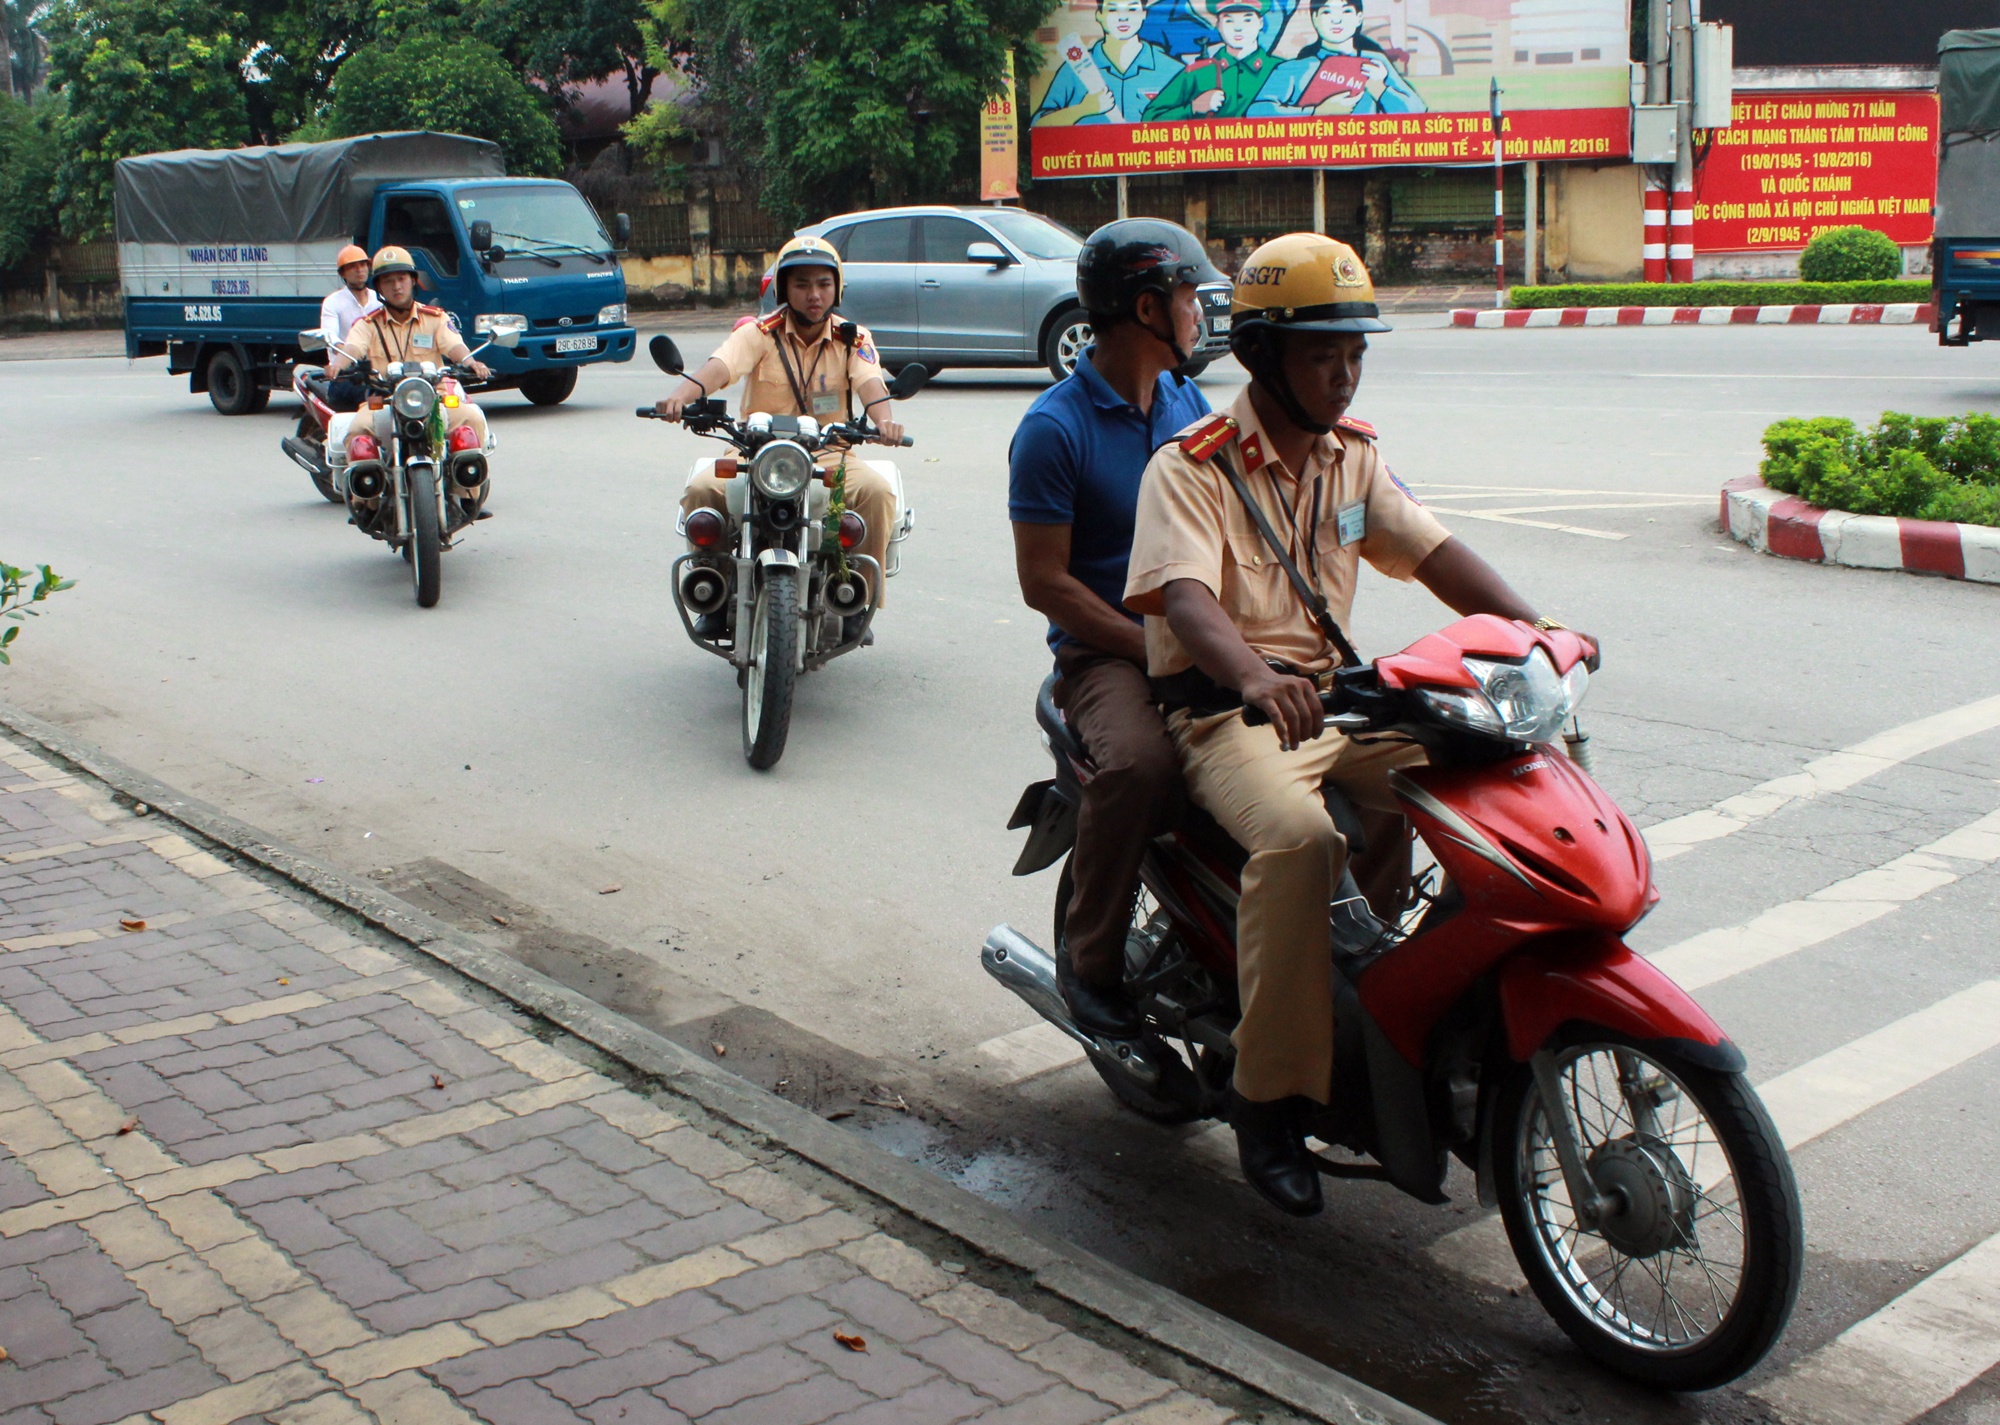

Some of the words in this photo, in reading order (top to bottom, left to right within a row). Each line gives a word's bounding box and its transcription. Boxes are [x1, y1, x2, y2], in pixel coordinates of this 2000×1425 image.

[1319, 70, 1345, 85] GIÁO
[1755, 102, 1778, 123] LIỆT
[1782, 101, 1812, 119] CHÀO
[1815, 101, 1849, 118] MỪNG
[1853, 103, 1864, 117] 71
[1869, 100, 1895, 117] NĂM
[1132, 124, 1168, 143] ĐẢNG
[1173, 125, 1190, 144] BỘ
[1194, 124, 1211, 140] VÀ
[1215, 122, 1253, 139] NHÂN
[1257, 121, 1285, 138] DÂN
[1289, 119, 1333, 139] HUYỆN
[1338, 119, 1365, 136] SÓC
[1370, 120, 1398, 135] SƠN
[1402, 120, 1421, 134] RA
[1425, 116, 1452, 134] SỨC
[1457, 118, 1478, 132] THI
[1482, 118, 1511, 132] ĐA
[1718, 127, 1748, 145] CÁCH
[1752, 129, 1786, 147] MẠNG
[1790, 126, 1827, 143] THÁNG
[1830, 125, 1854, 142] TÁM
[1858, 124, 1894, 142] THÀNH
[1898, 124, 1928, 141] CÔNG
[1043, 151, 1081, 170] QUYẾT
[1086, 152, 1113, 167] TÂM
[1117, 151, 1151, 168] THỰC
[1155, 148, 1186, 167] HIỆN
[1190, 144, 1233, 163] THẮNG
[1238, 146, 1258, 164] LỢI
[1262, 143, 1306, 163] NHIỆM
[1310, 145, 1328, 162] VỤ
[1332, 141, 1367, 158] PHÁT
[1371, 138, 1410, 157] TRIỂN
[1415, 142, 1448, 156] KINH
[1452, 137, 1468, 156] TẾ
[1505, 137, 1528, 157] HỘI
[1533, 137, 1565, 154] NĂM
[1570, 138, 1609, 153] 2016!
[1742, 153, 1801, 170] (19/8/1945
[1813, 152, 1871, 167] 19/8/2016)
[1761, 175, 1776, 193] VÀ
[1779, 173, 1809, 194] QUỐC
[1813, 174, 1851, 192] KHÁNH
[1713, 201, 1744, 222] CỘNG
[1748, 200, 1771, 218] HOÀ
[1774, 200, 1790, 217] XÃ
[1793, 199, 1812, 220] HỘI
[1815, 195, 1838, 216] CHỦ
[1841, 197, 1875, 215] NGHĨA
[1878, 196, 1901, 217] VIỆT
[1904, 199, 1930, 213] NAM
[1748, 227, 1800, 244] (2/9/1945
[240, 245, 268, 262] HÀNG
[1238, 266, 1286, 286] CSGT
